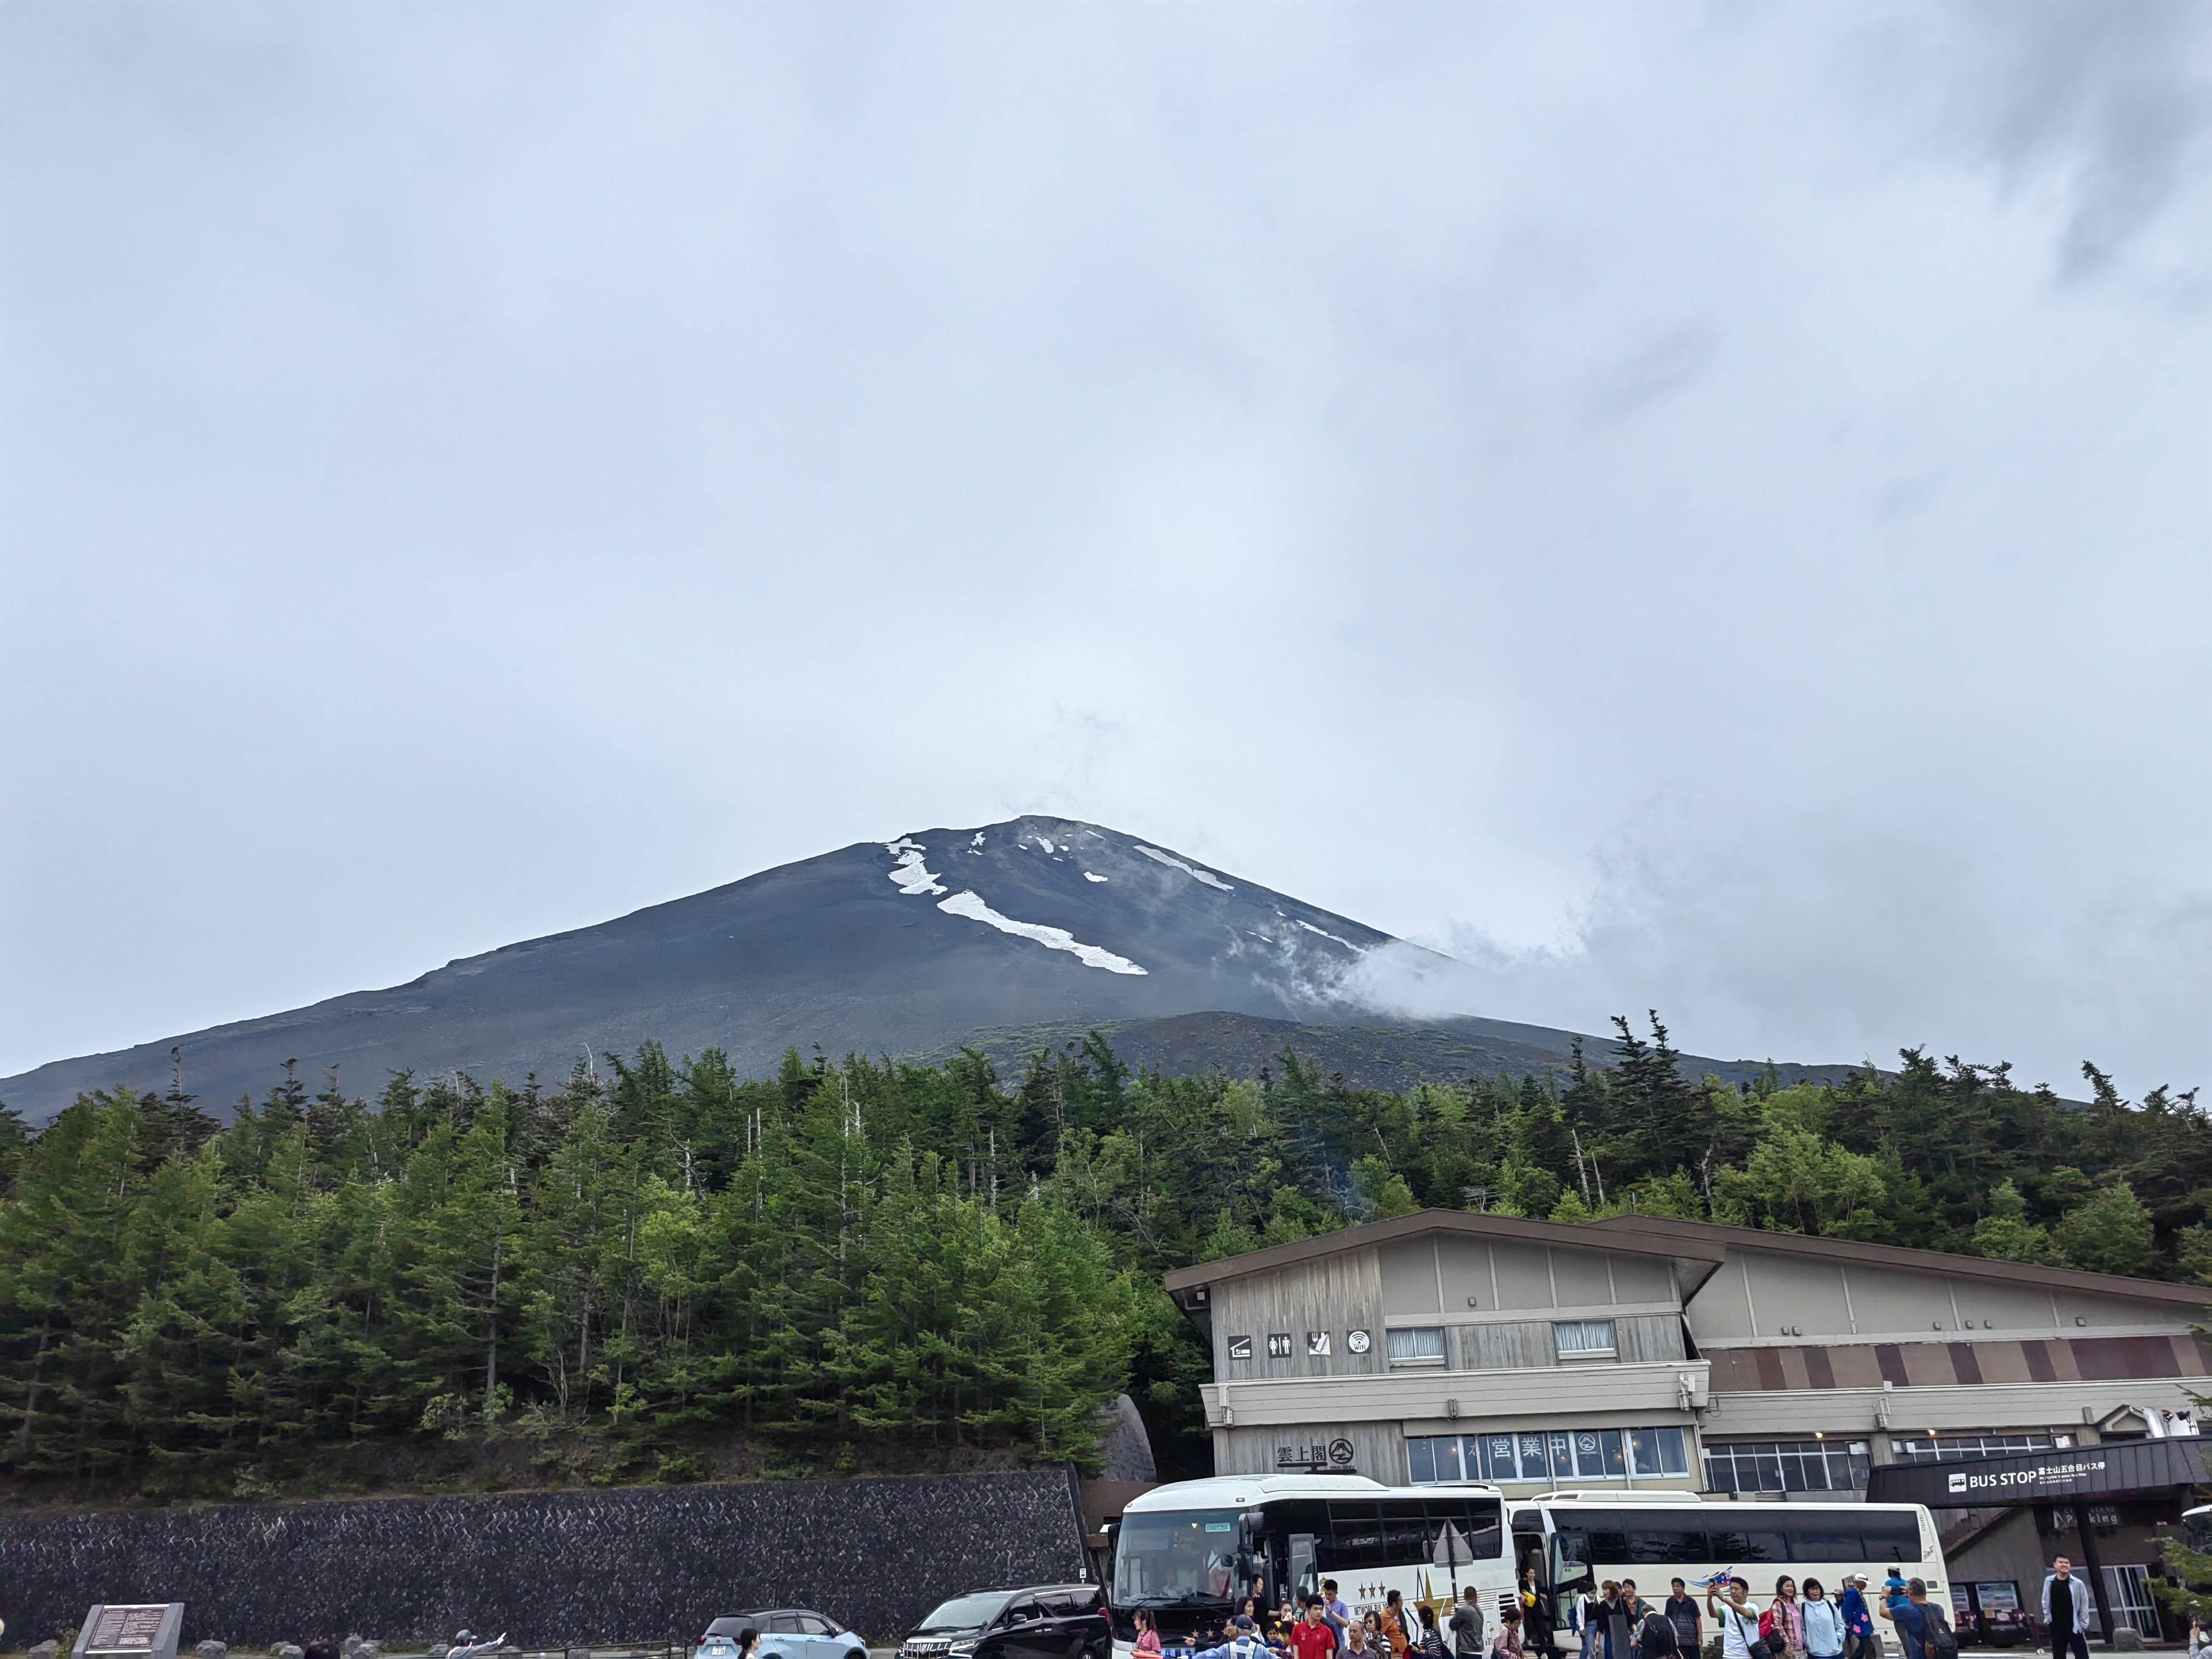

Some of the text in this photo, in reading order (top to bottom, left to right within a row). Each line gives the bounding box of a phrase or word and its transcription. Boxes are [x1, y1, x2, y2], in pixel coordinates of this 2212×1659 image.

[1277, 1445, 1326, 1462] 雲上閣
[1492, 1435, 1566, 1458] 営業中
[2038, 1461, 2105, 1475] 富士山五合目バス停
[1970, 1474, 1997, 1488] BUS
[2000, 1471, 2036, 1486] STOP
